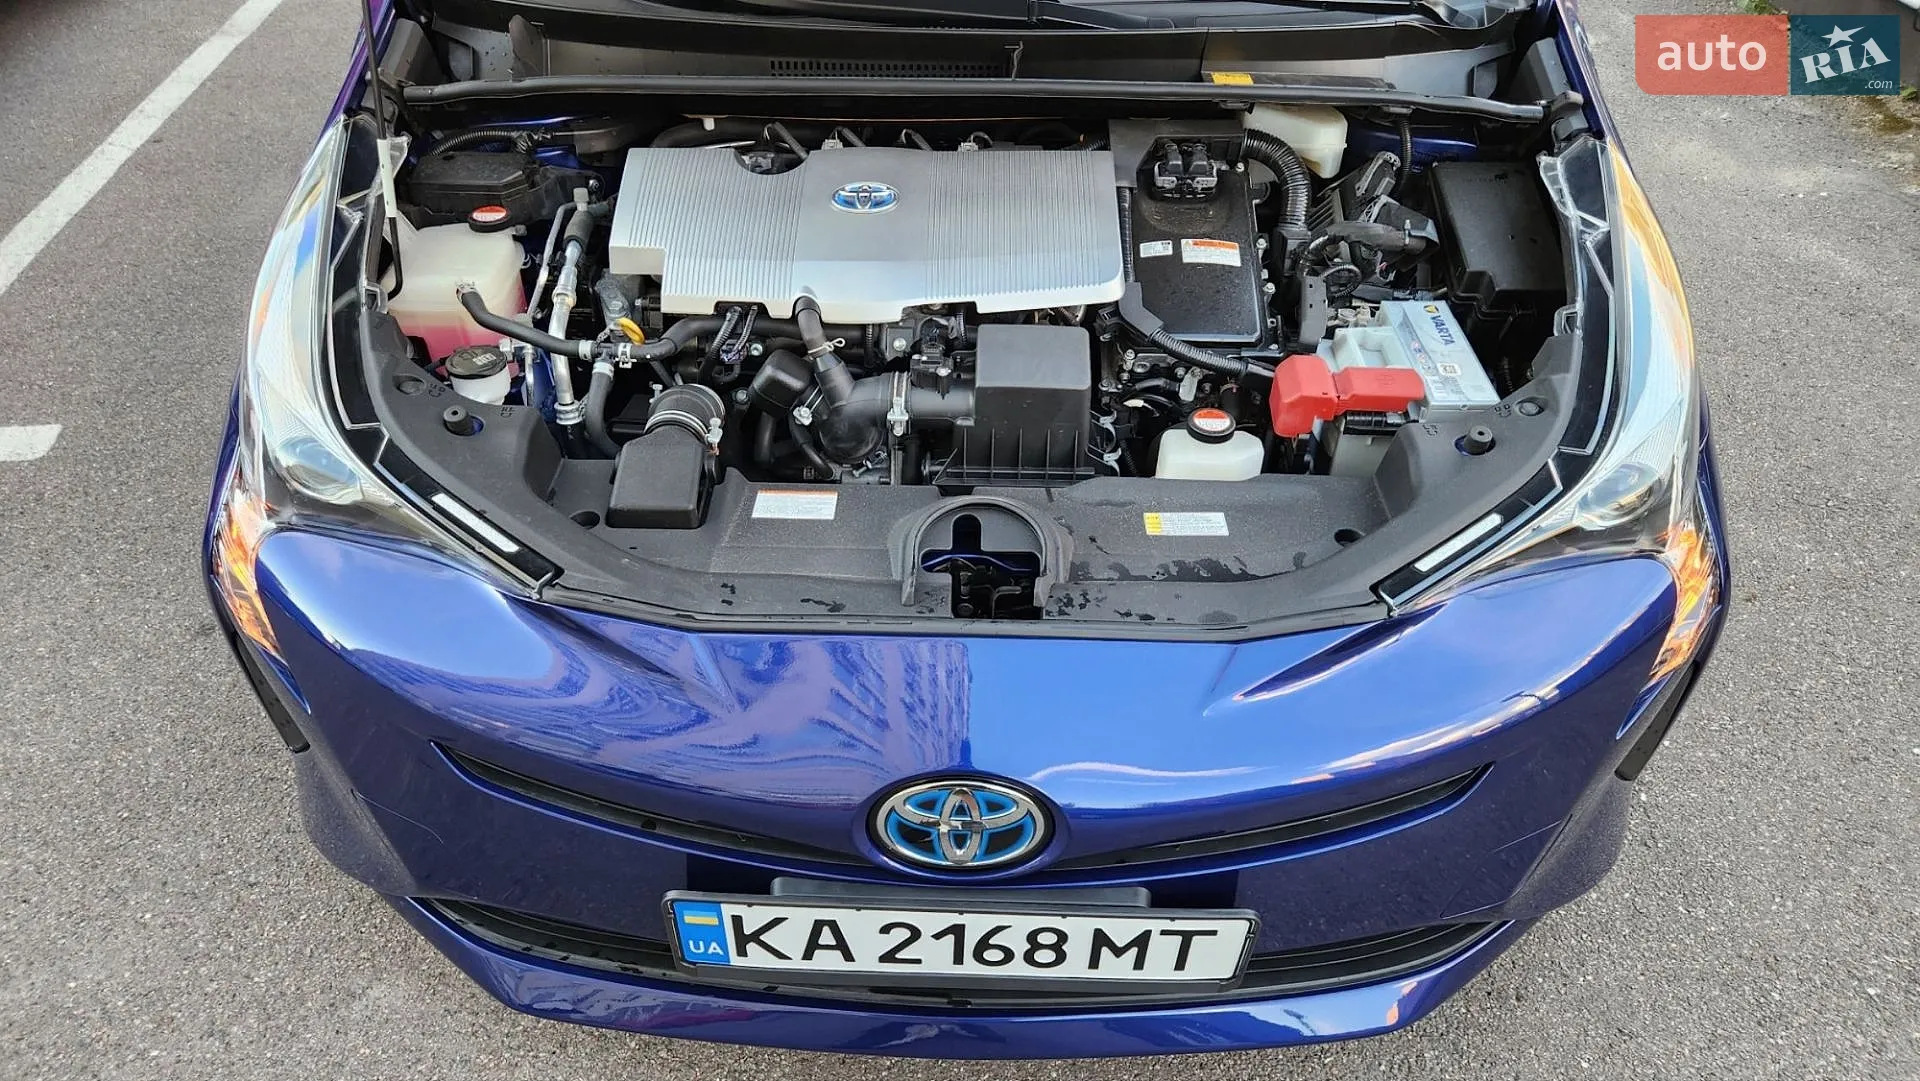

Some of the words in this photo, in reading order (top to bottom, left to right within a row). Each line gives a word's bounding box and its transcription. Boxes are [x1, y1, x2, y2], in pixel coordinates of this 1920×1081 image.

[1429, 314, 1456, 346] VARTA
[689, 939, 724, 957] UA
[731, 914, 855, 962] KA
[878, 921, 1067, 968] 2168
[1089, 928, 1219, 971] MT
